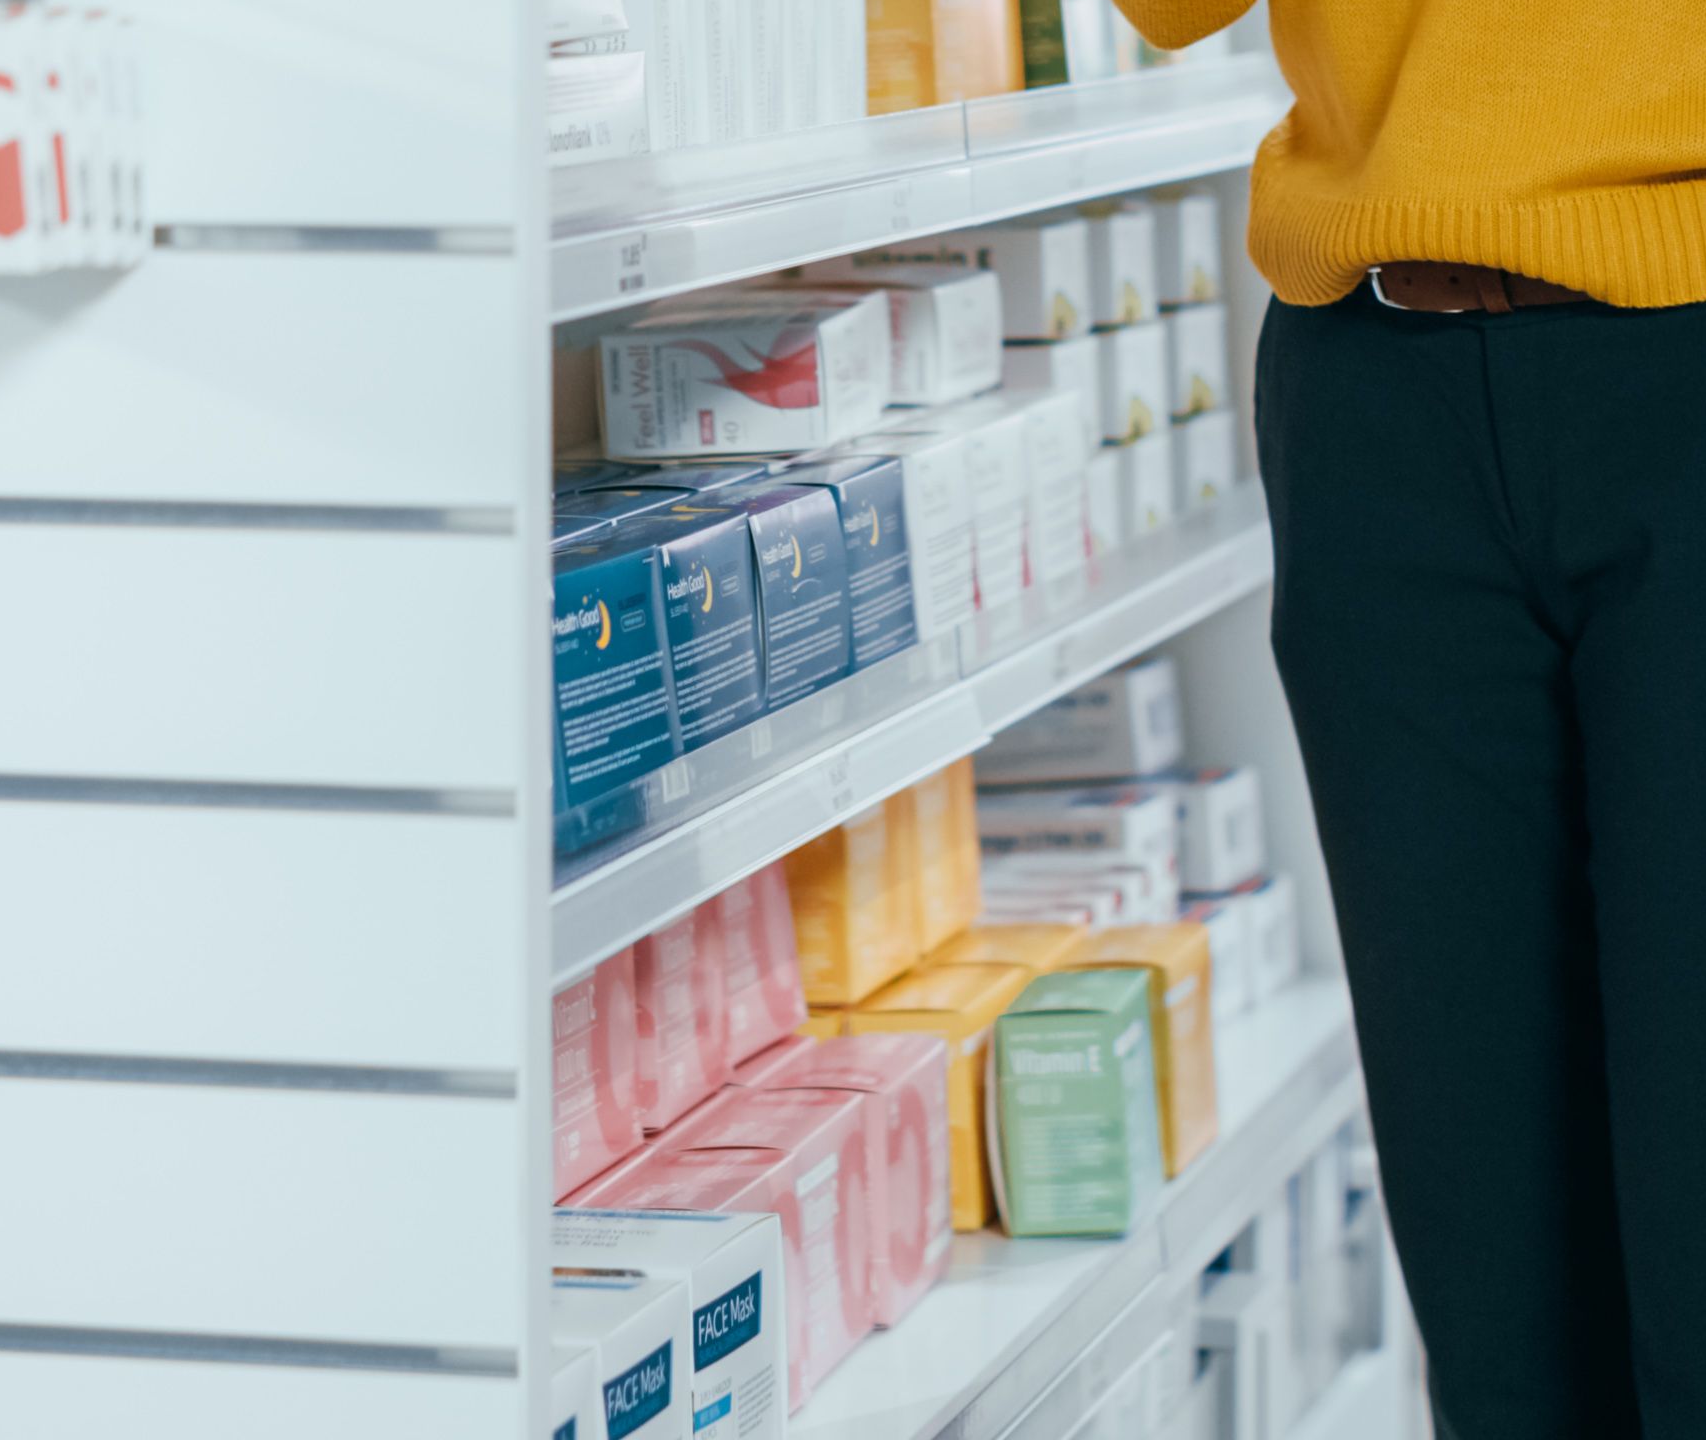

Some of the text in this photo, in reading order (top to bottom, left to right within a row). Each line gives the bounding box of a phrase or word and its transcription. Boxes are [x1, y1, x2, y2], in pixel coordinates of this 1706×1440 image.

[627, 345, 655, 450] Feel Well
[666, 569, 705, 601] Health Good
[578, 603, 600, 629] Good
[1009, 1043, 1101, 1075] Vitamin E
[697, 1284, 756, 1347] FACE Mask
[606, 1353, 667, 1421] FACE Mask
